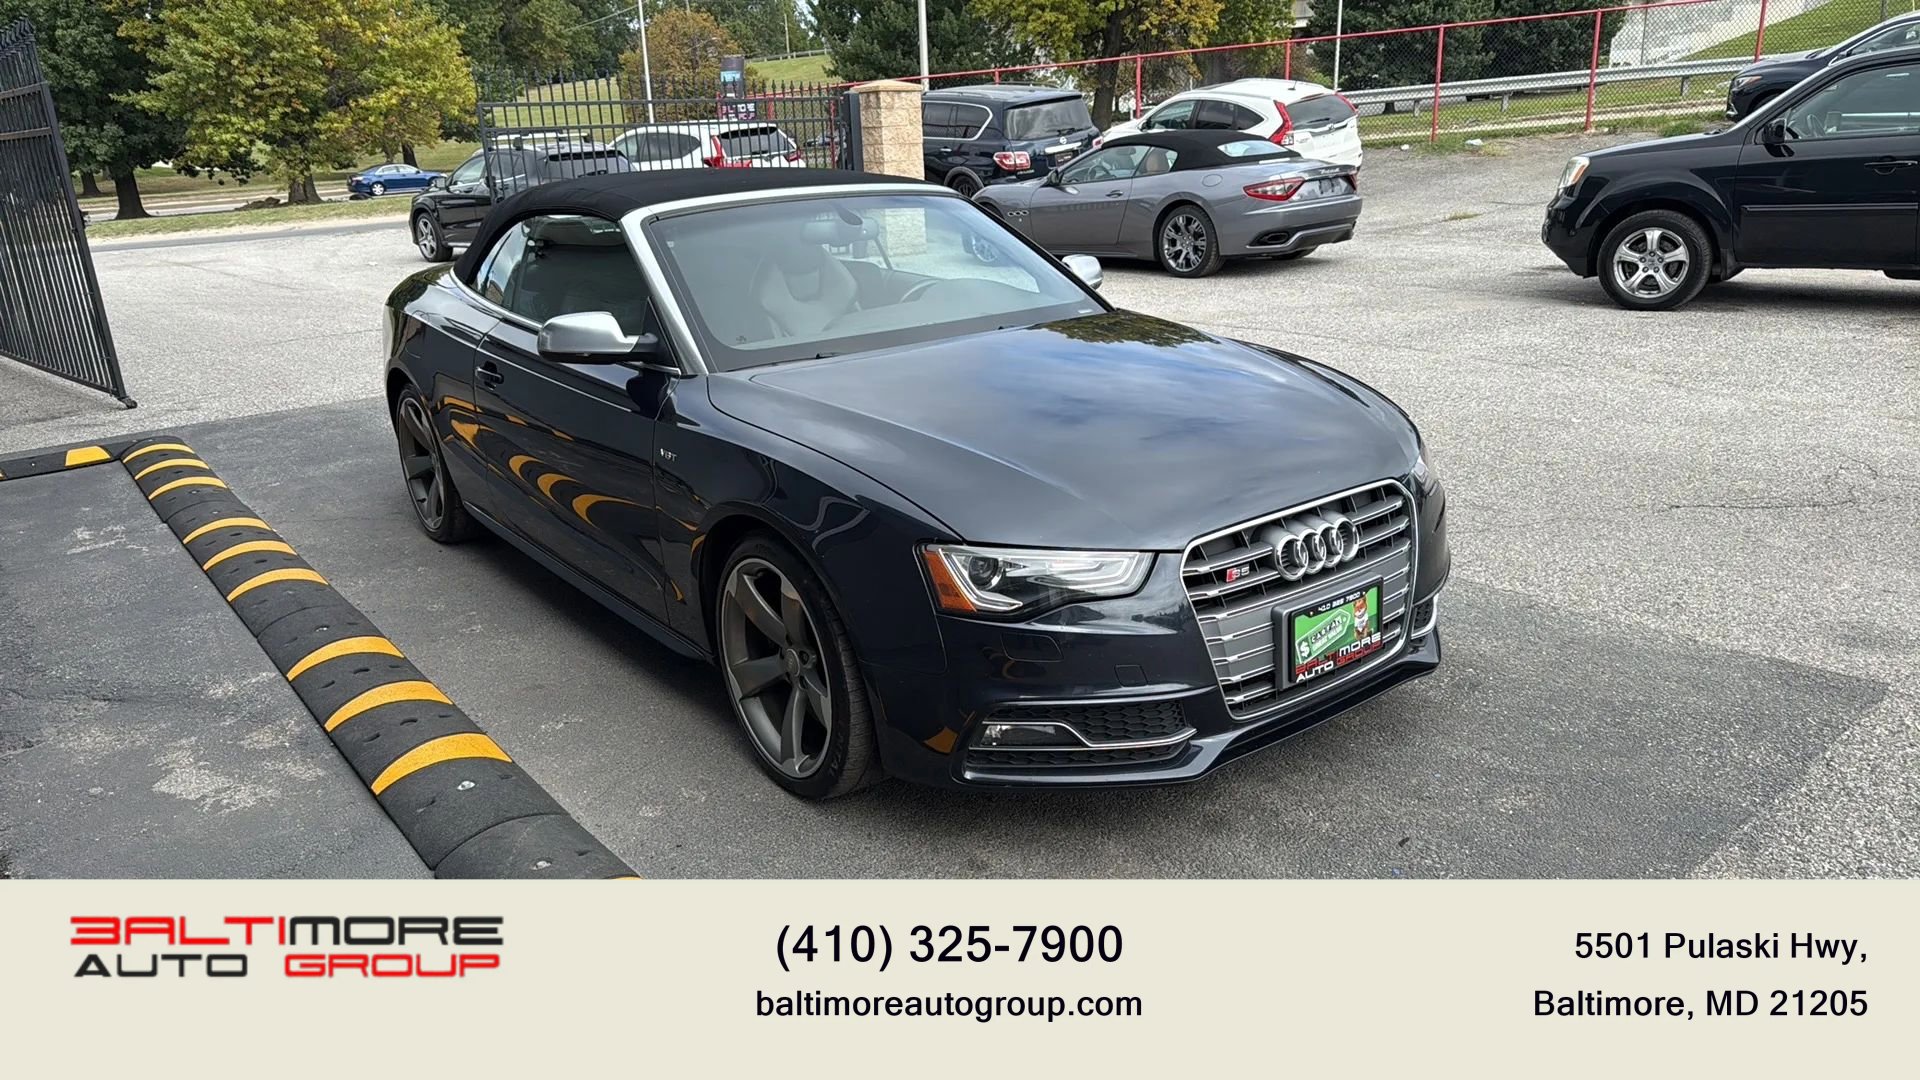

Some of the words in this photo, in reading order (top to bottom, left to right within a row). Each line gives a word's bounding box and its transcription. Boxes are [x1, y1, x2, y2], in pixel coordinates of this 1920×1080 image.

[1227, 566, 1250, 582] S5
[1296, 632, 1381, 675] BALTIMORE
[1296, 660, 1334, 683] AUTO
[1336, 640, 1382, 666] GROUP
